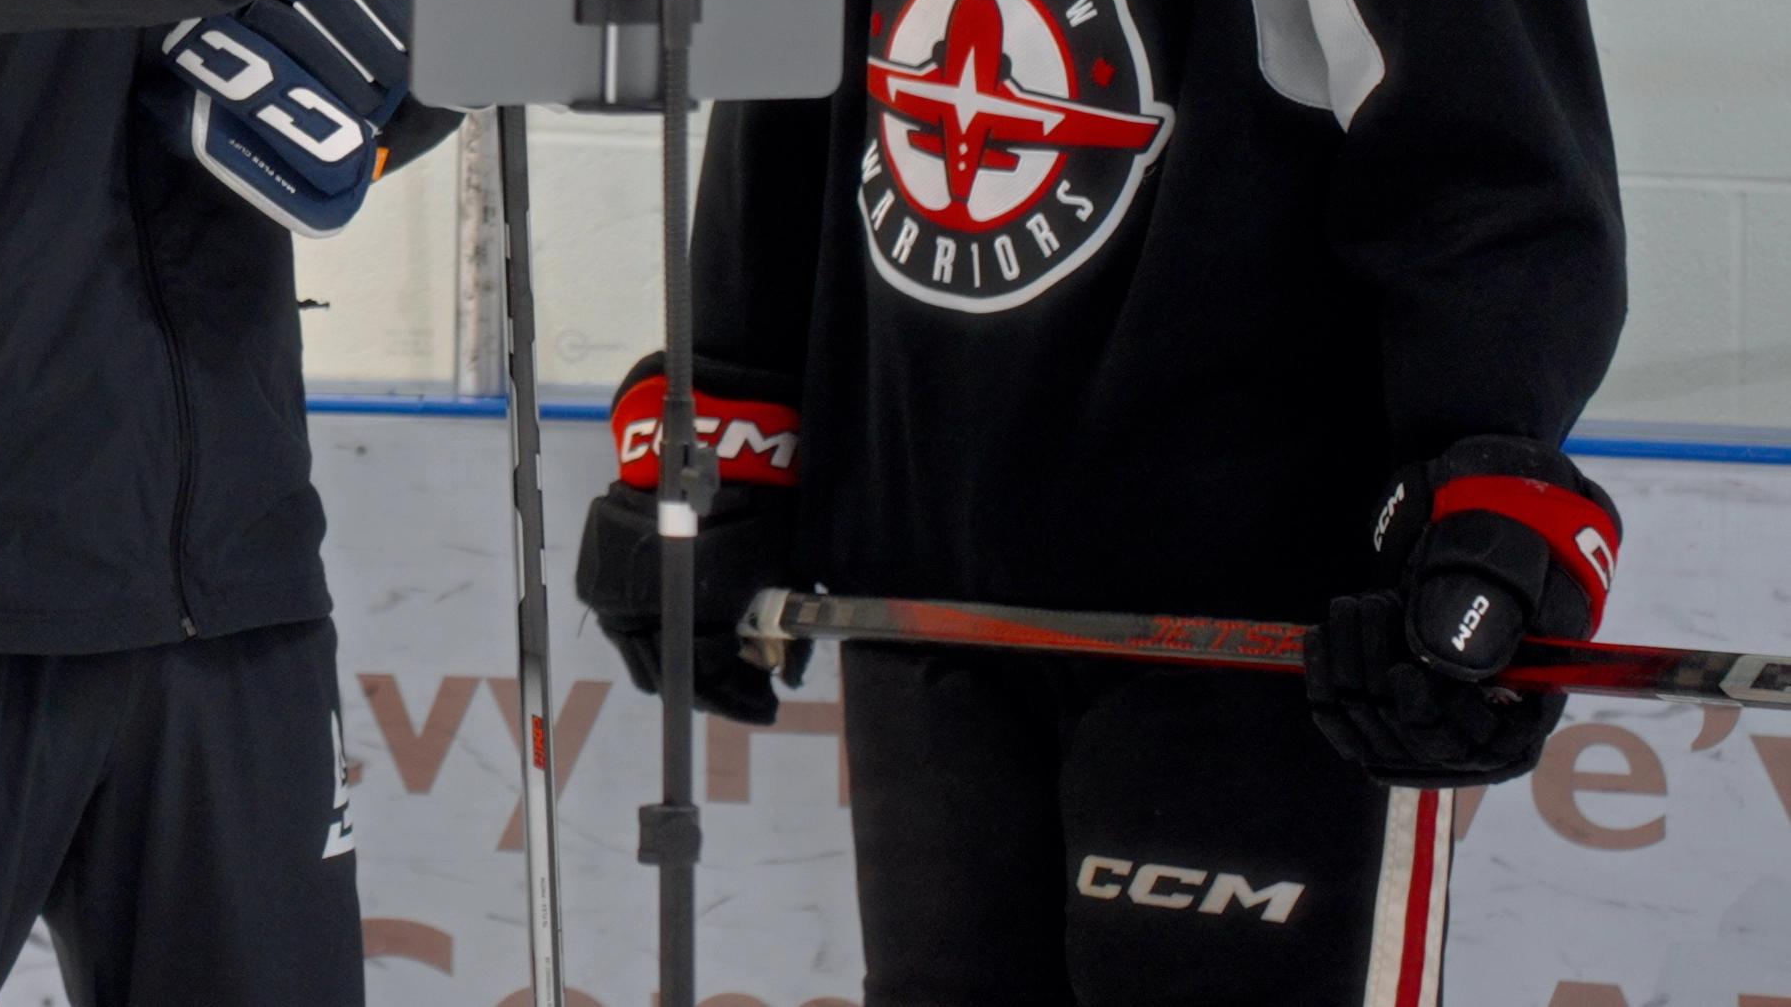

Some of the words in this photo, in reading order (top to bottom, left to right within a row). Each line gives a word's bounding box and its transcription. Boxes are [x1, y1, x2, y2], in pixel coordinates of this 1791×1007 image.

[861, 139, 1094, 289] WARRIORS
[1373, 481, 1405, 553] CCM
[1451, 594, 1490, 653] CCM
[1076, 854, 1306, 924] CCM
